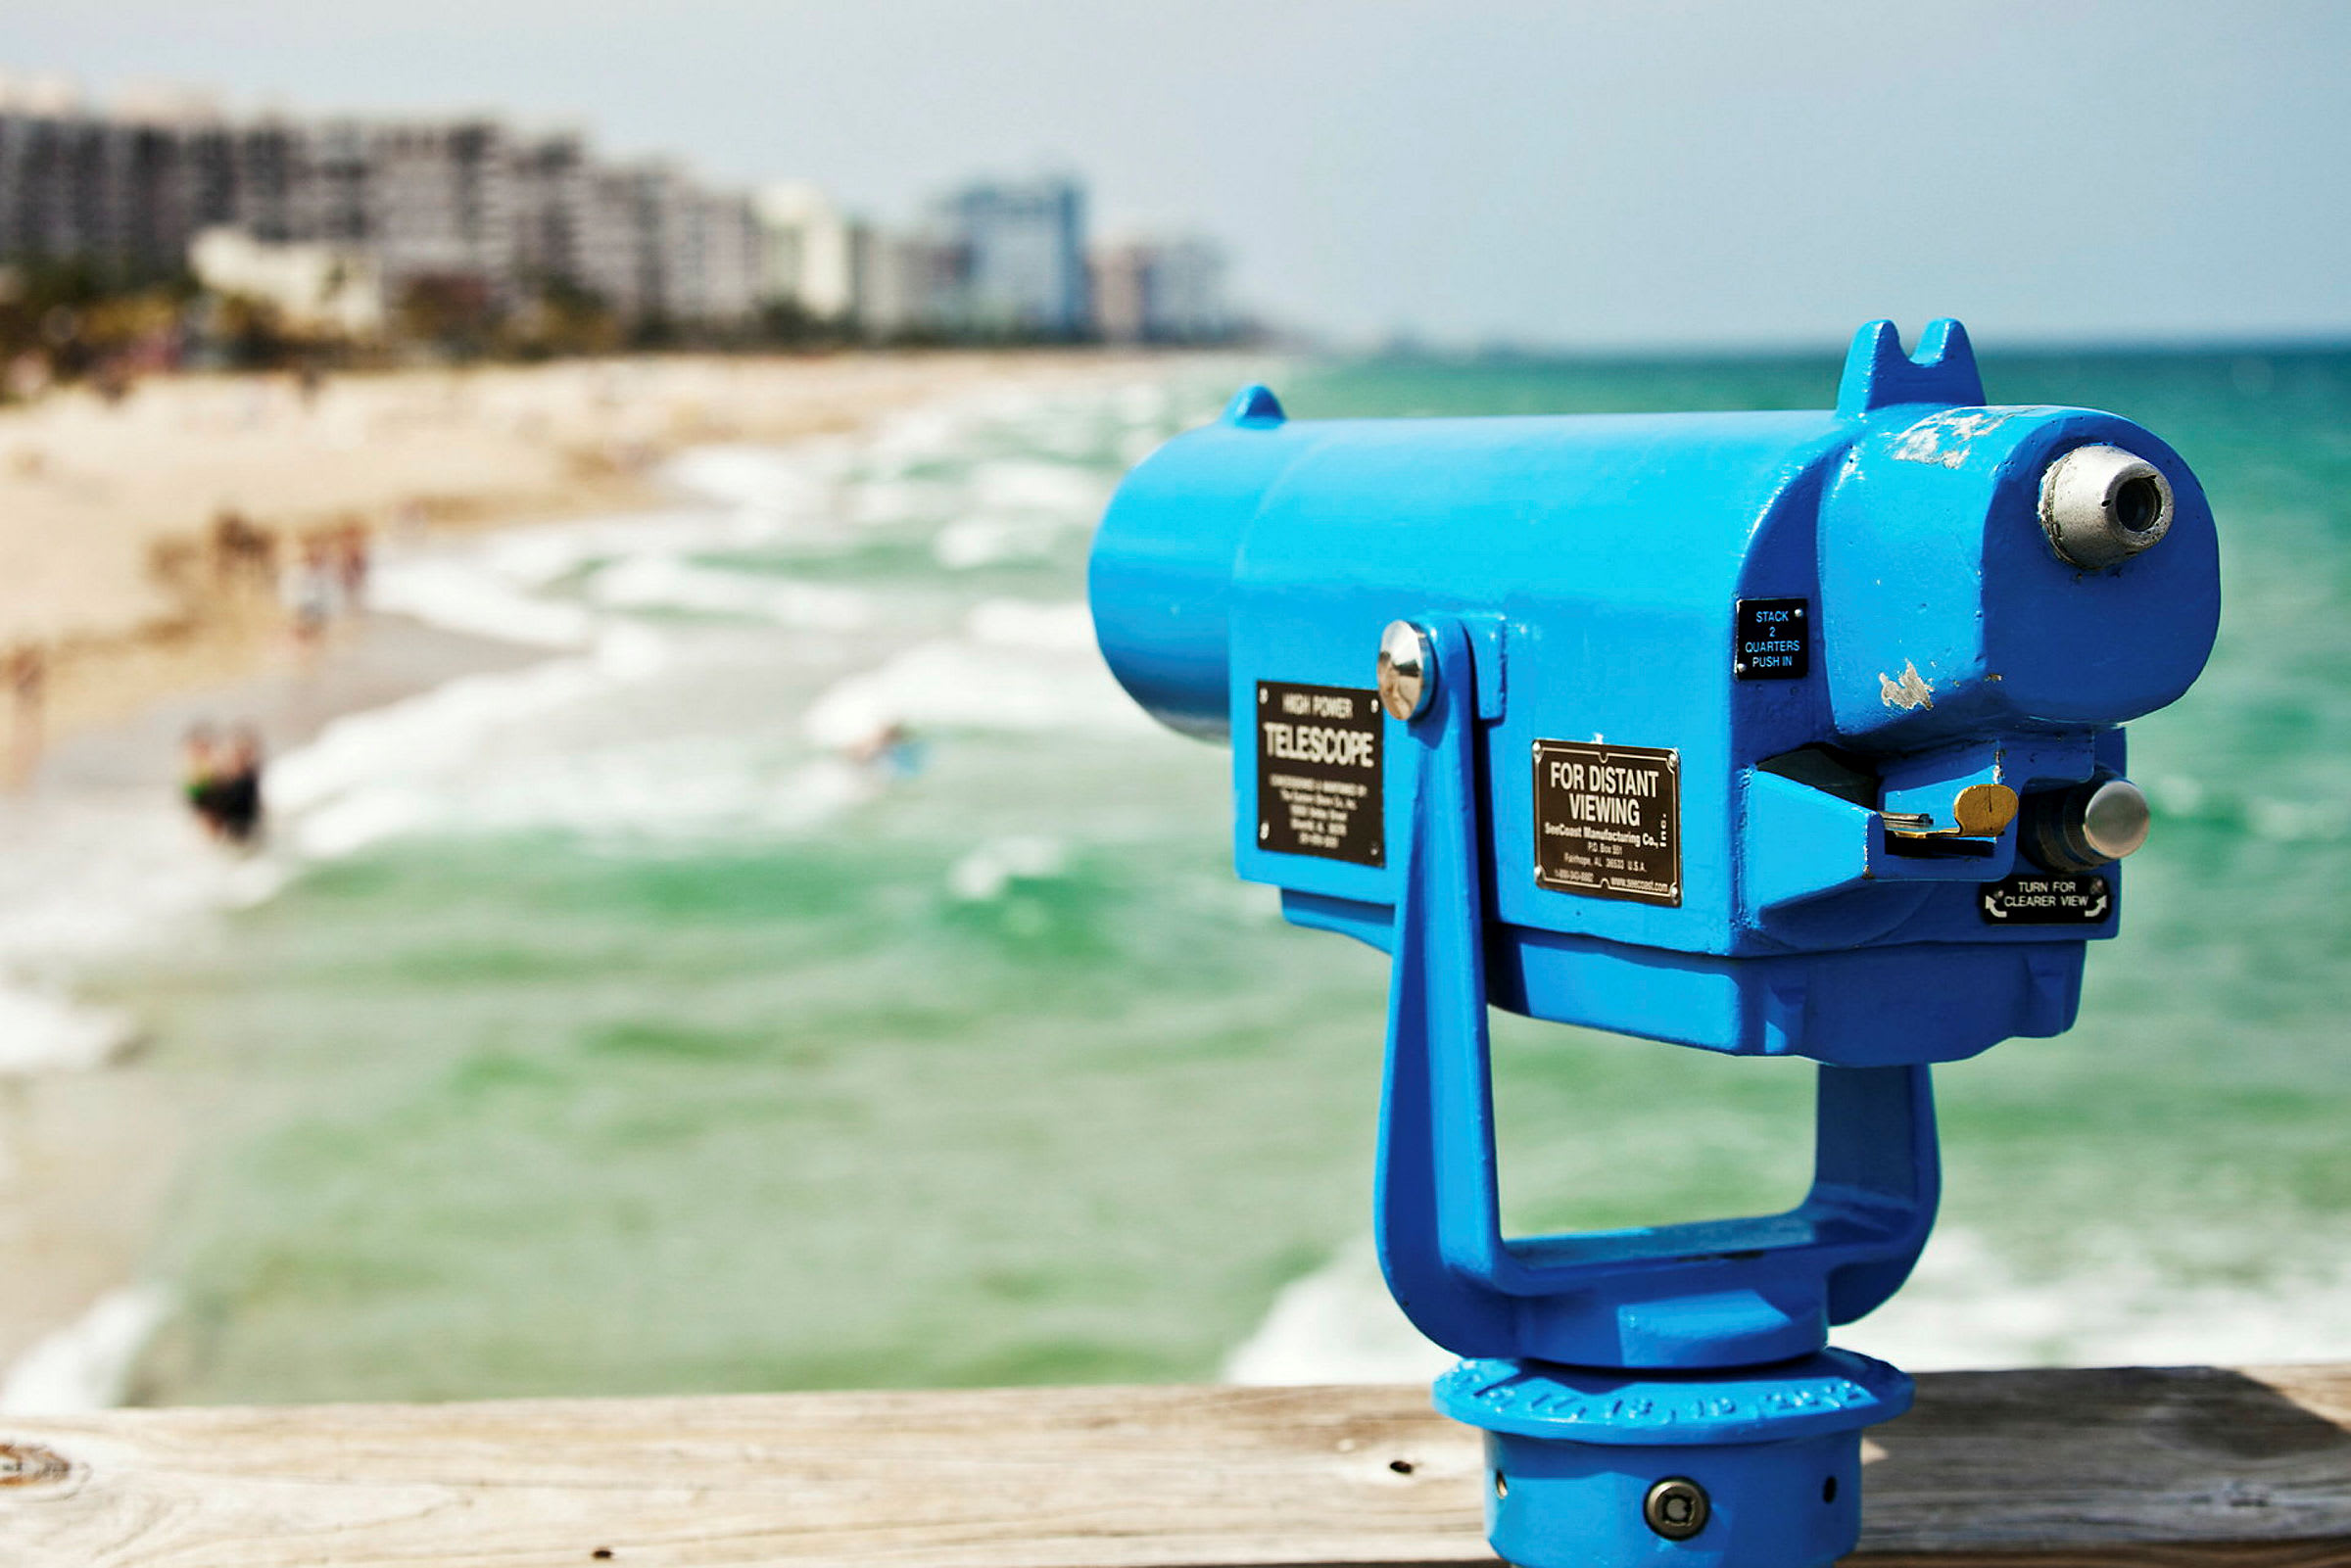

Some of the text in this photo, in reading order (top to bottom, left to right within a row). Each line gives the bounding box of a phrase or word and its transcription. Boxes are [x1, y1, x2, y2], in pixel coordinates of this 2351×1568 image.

[1755, 610, 1789, 624] STACK
[1769, 626, 1776, 638] 2
[1745, 640, 1800, 653] QUARTERS
[1751, 655, 1793, 668] PUSH IN
[1281, 692, 1354, 720] HIGH POWER
[1263, 721, 1374, 768] TELESCOPE
[1551, 761, 1659, 797] FOR DISTANT
[1569, 793, 1640, 827] VIEWING
[1544, 822, 1582, 838] SeeCoast
[1583, 827, 1641, 847] Manufacturing
[1600, 843, 1611, 855] Box
[2018, 881, 2077, 893] TURN FOR
[2003, 895, 2088, 908] CLEARER VIEW
